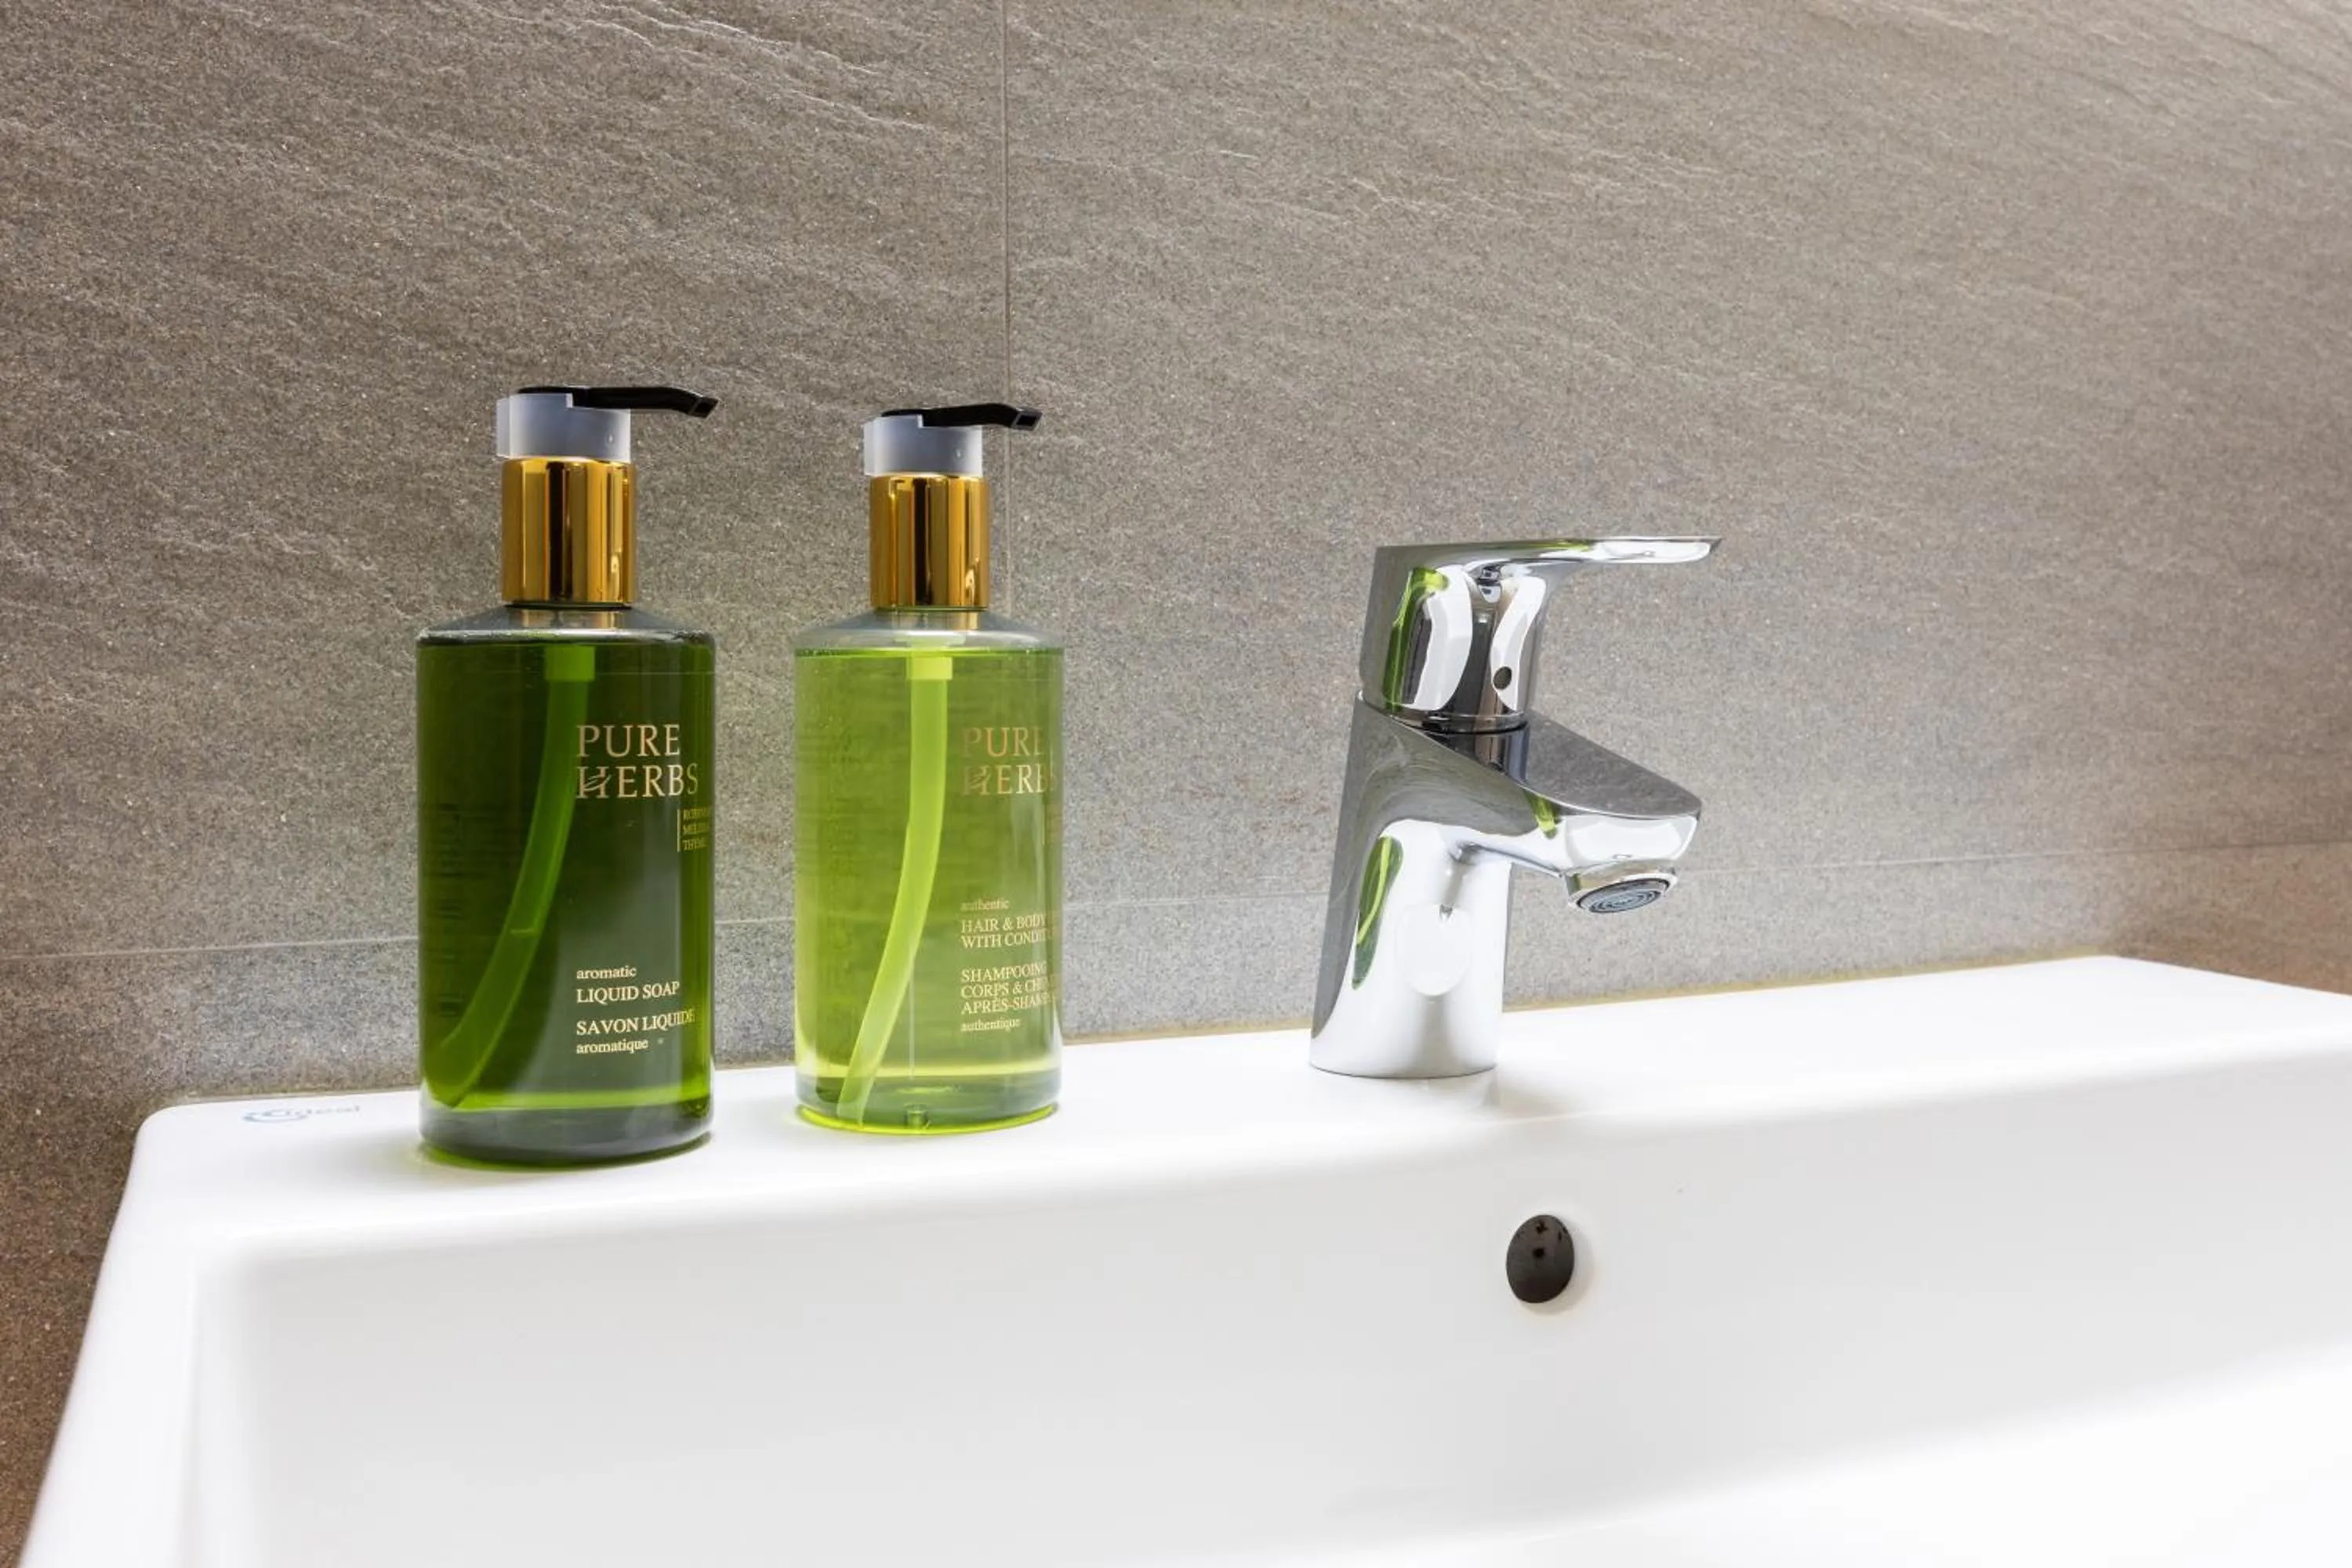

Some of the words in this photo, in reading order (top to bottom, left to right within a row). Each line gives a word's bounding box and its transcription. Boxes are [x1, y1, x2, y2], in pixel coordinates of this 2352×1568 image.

[576, 724, 681, 758] PURE
[962, 725, 1046, 758] PURE
[576, 762, 699, 799] HERBS
[961, 918, 999, 933] HAIR
[1003, 917, 1013, 931] &
[961, 934, 1001, 949] WITH
[576, 964, 637, 979] aromatic
[576, 985, 640, 1005] LIQUID
[642, 981, 680, 1000] SOAP
[960, 982, 1009, 998] CORPS
[1012, 981, 1022, 994] &
[576, 1016, 639, 1035] SAVON
[641, 1008, 695, 1031] LIQUIDE
[960, 1017, 1021, 1032] authentique
[576, 1038, 649, 1054] aromatique
